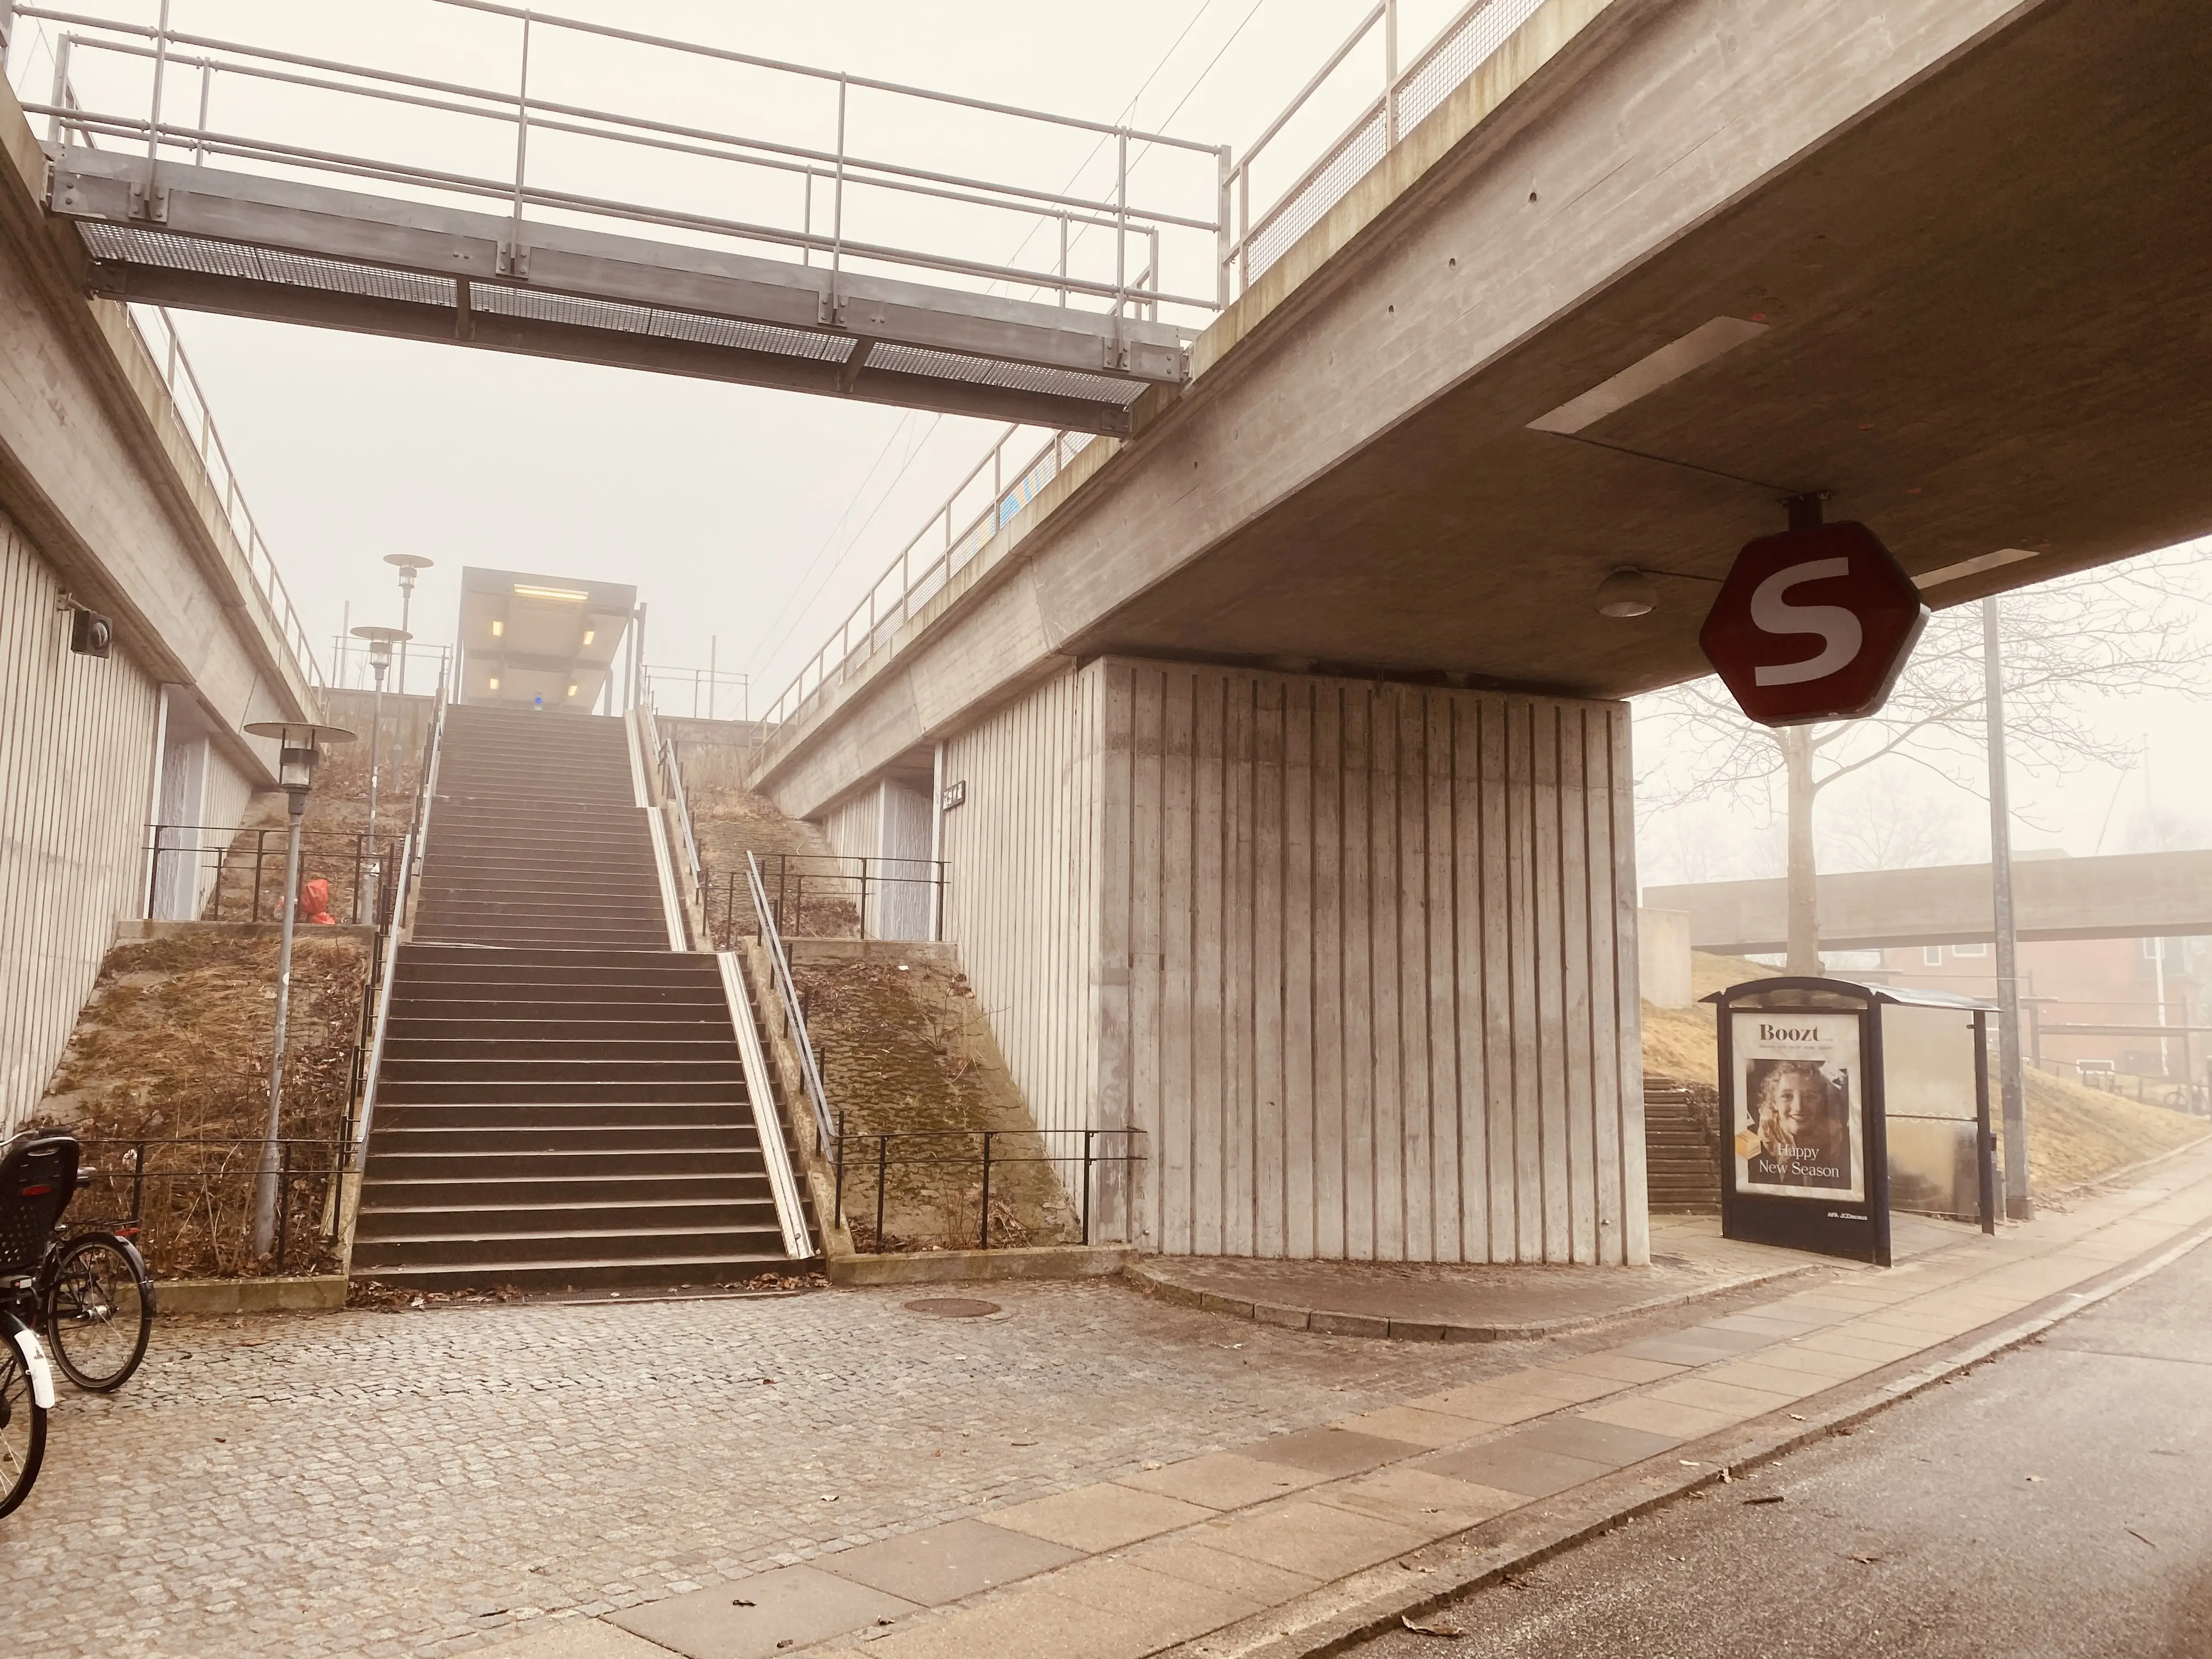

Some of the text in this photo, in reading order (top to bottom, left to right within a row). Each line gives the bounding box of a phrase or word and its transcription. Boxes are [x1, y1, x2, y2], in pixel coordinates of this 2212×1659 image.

[1751, 556, 1863, 686] S
[1759, 1024, 1819, 1042] Boozt
[1778, 1143, 1820, 1161] Happy
[1759, 1159, 1840, 1178] New Season
